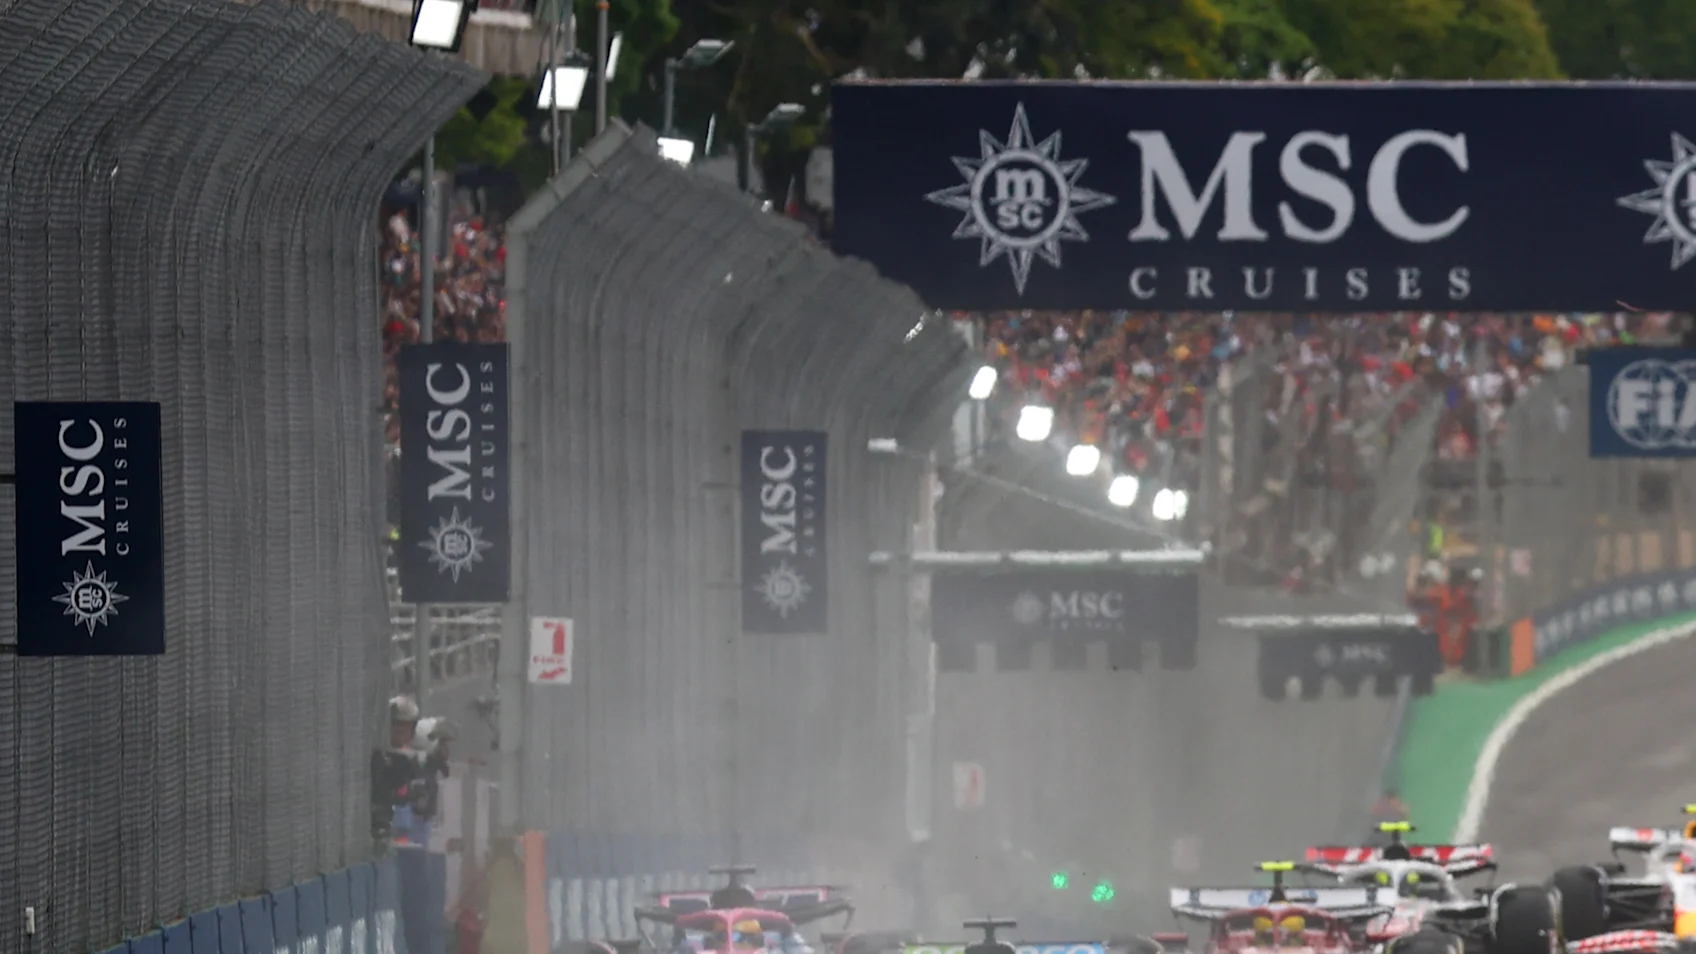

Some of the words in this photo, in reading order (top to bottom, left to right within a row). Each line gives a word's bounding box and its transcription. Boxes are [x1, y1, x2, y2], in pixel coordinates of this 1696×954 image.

[1128, 130, 1470, 243] MSC
[1130, 267, 1471, 300] CRUISES
[58, 419, 106, 556] MSC
[114, 417, 130, 556] CRUISES
[426, 363, 471, 502] MSC
[480, 361, 495, 502] CRUISES
[760, 445, 797, 555] MSC
[1049, 591, 1124, 620] MSC
